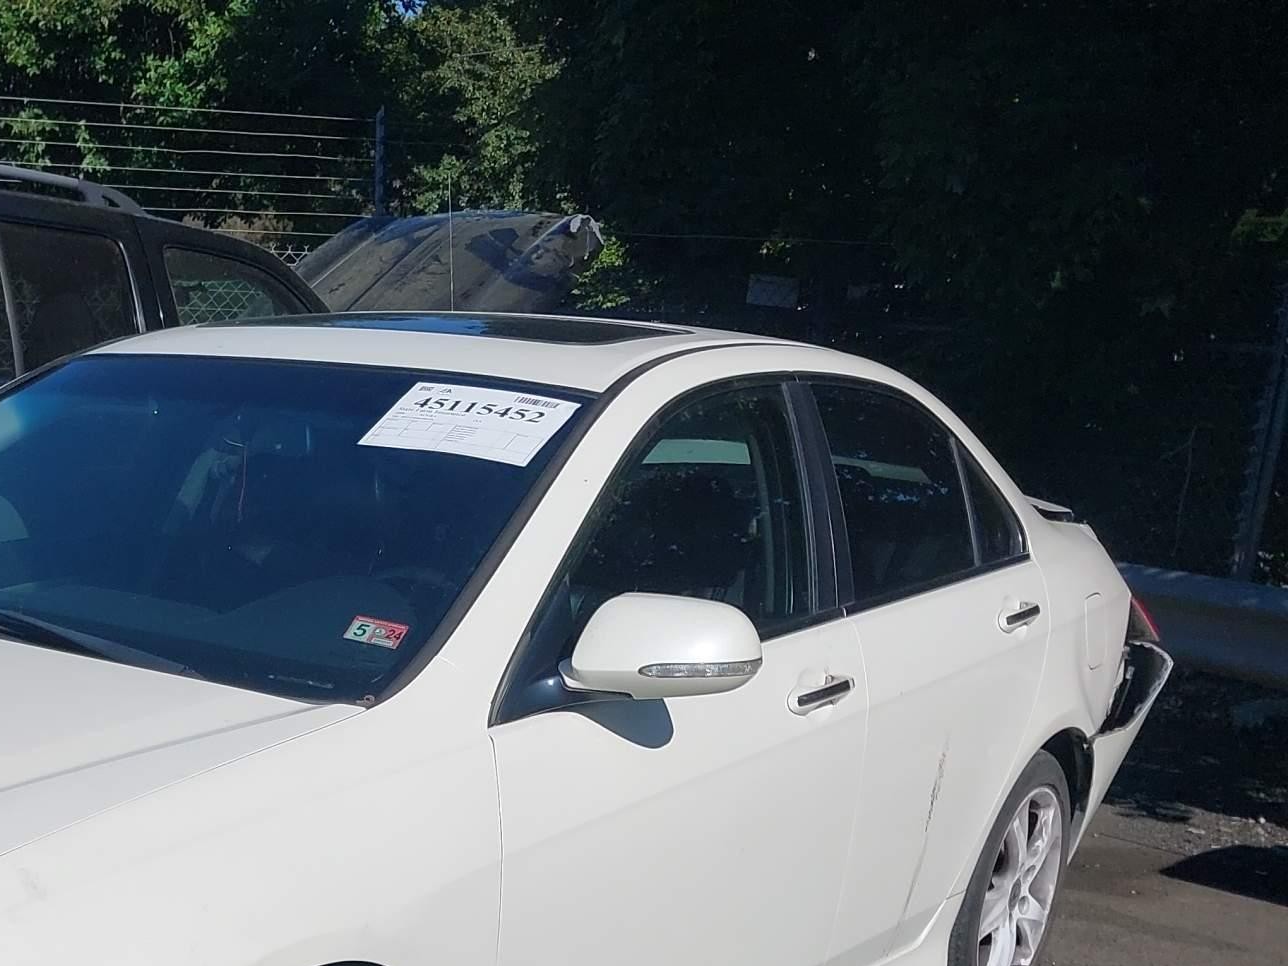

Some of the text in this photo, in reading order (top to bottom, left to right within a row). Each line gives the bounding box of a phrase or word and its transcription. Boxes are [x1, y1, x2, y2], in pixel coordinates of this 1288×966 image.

[414, 397, 545, 423] 45115452
[353, 624, 403, 641] 5 24
